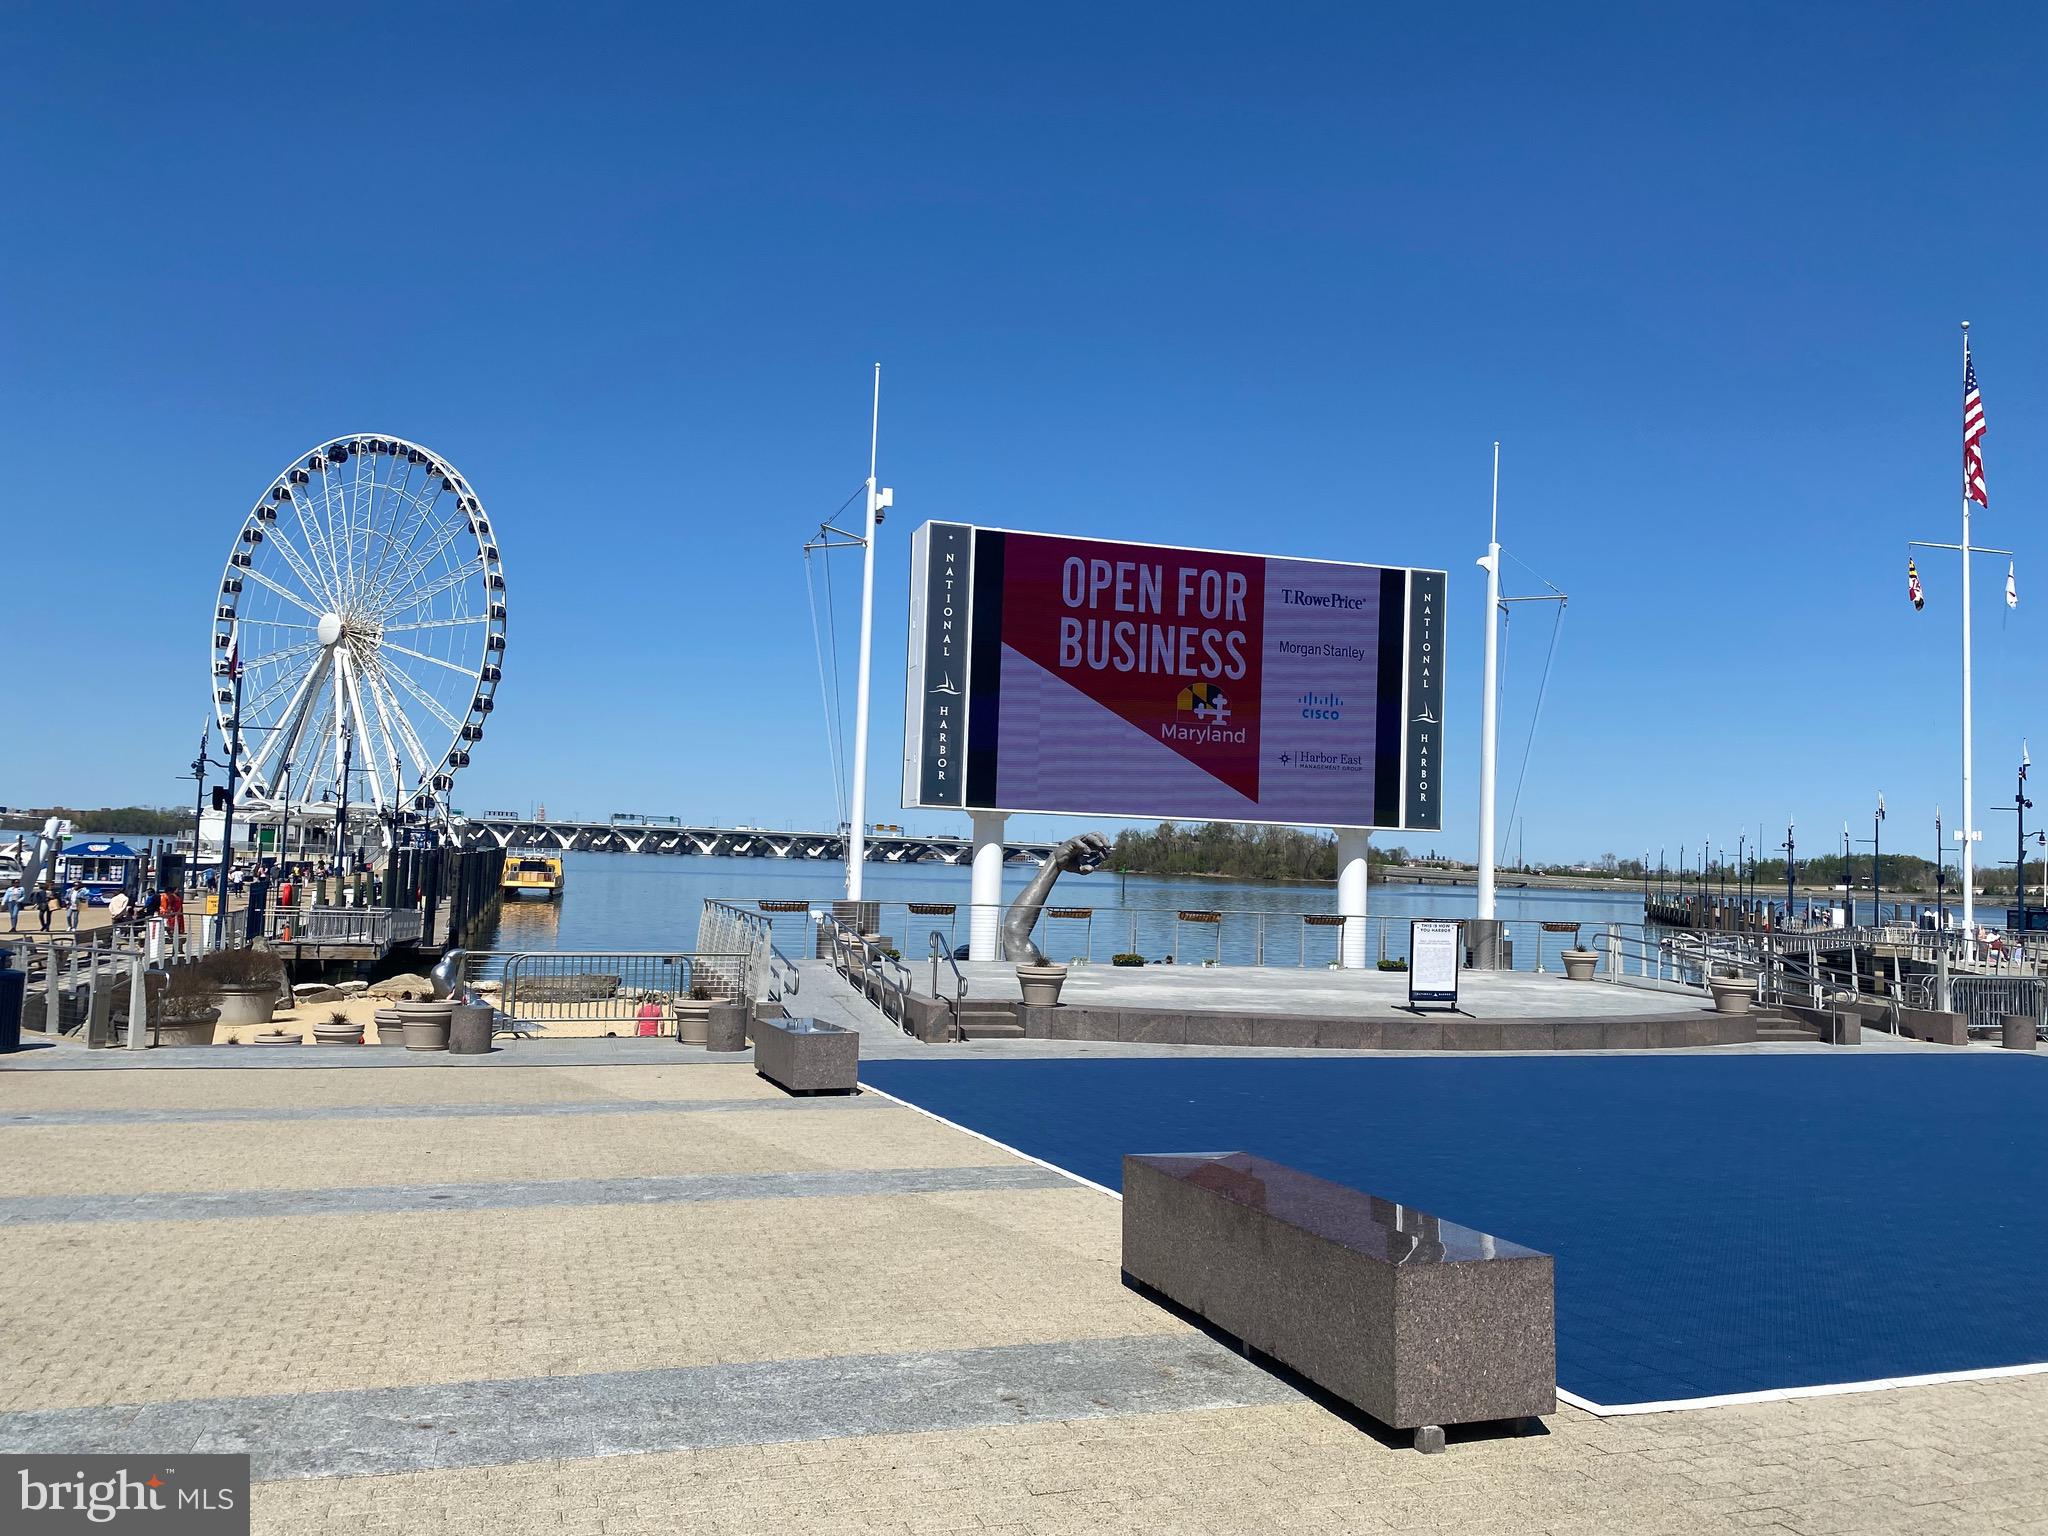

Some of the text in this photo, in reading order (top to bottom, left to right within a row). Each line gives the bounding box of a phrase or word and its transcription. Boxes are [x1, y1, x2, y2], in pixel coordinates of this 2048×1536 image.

[1062, 556, 1247, 621] OPEN FOR
[937, 553, 955, 780] NATIONAL HARBOR
[1059, 616, 1246, 680] BUSINESS
[1279, 640, 1365, 662] Morgan Stanley
[1419, 593, 1432, 802] NATIONAL HARBOR
[1161, 723, 1246, 745] Maryland
[1299, 763, 1340, 771] MANAGEMENT
[1300, 751, 1363, 765] Harbor East
